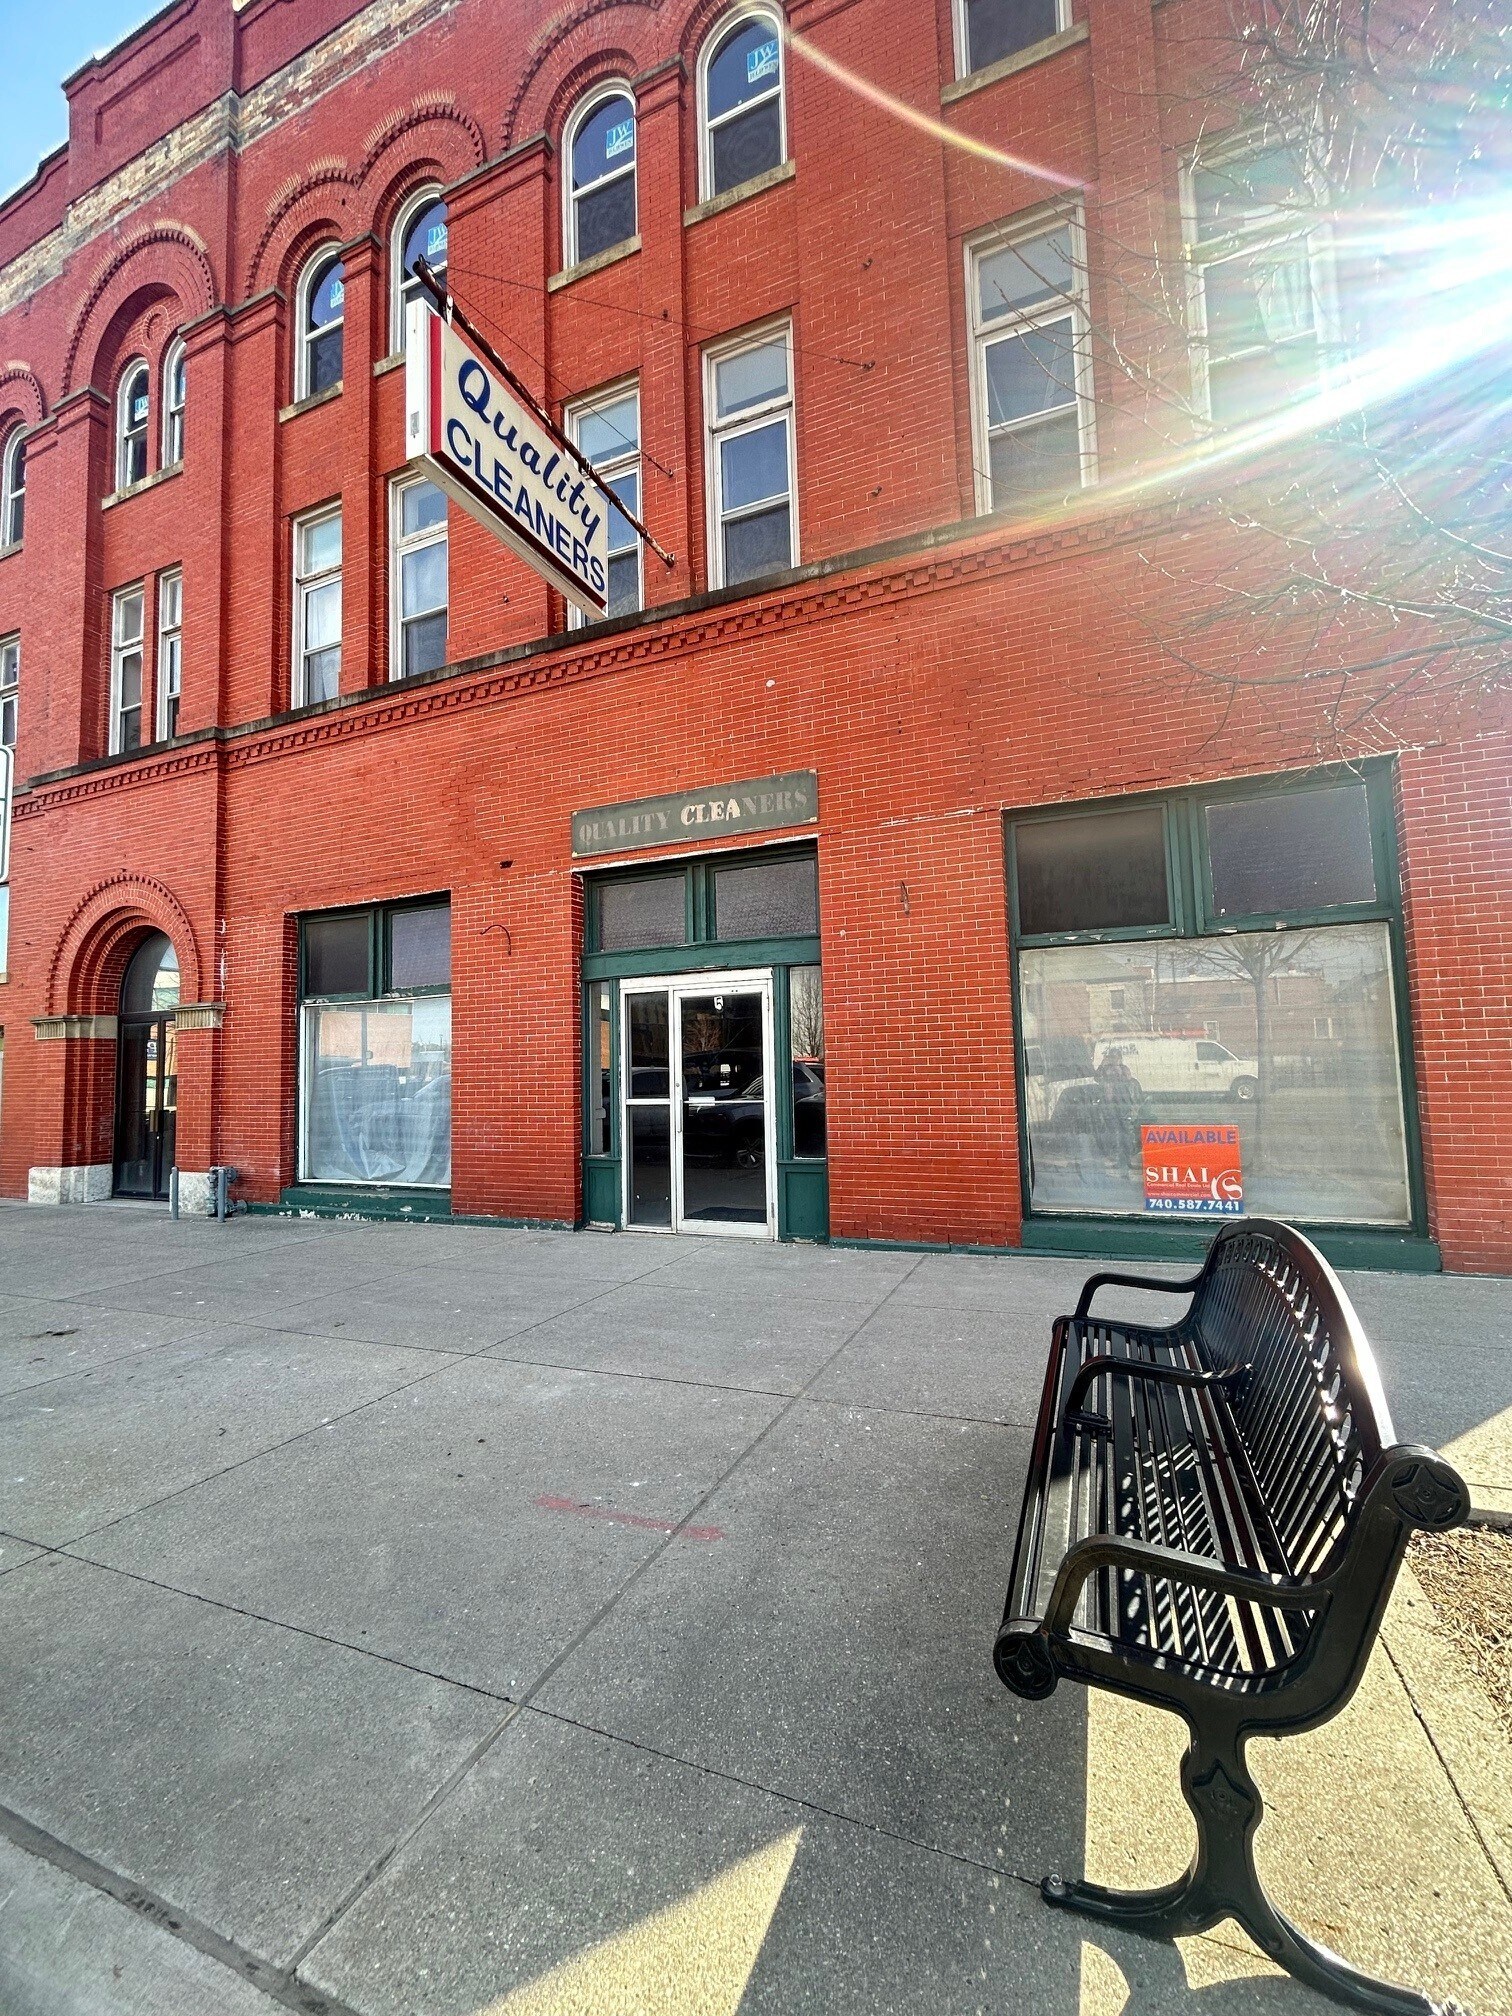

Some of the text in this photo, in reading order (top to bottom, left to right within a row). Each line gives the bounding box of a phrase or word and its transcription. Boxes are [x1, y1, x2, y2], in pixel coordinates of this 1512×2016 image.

[458, 359, 601, 546] Quality
[447, 418, 605, 592] CLEANERS
[578, 788, 808, 845] QUALITY CLEANERS
[1146, 1130, 1237, 1145] AVAILABLE
[1145, 1166, 1209, 1183] SHAI
[1149, 1198, 1240, 1211] 740.587.7441
